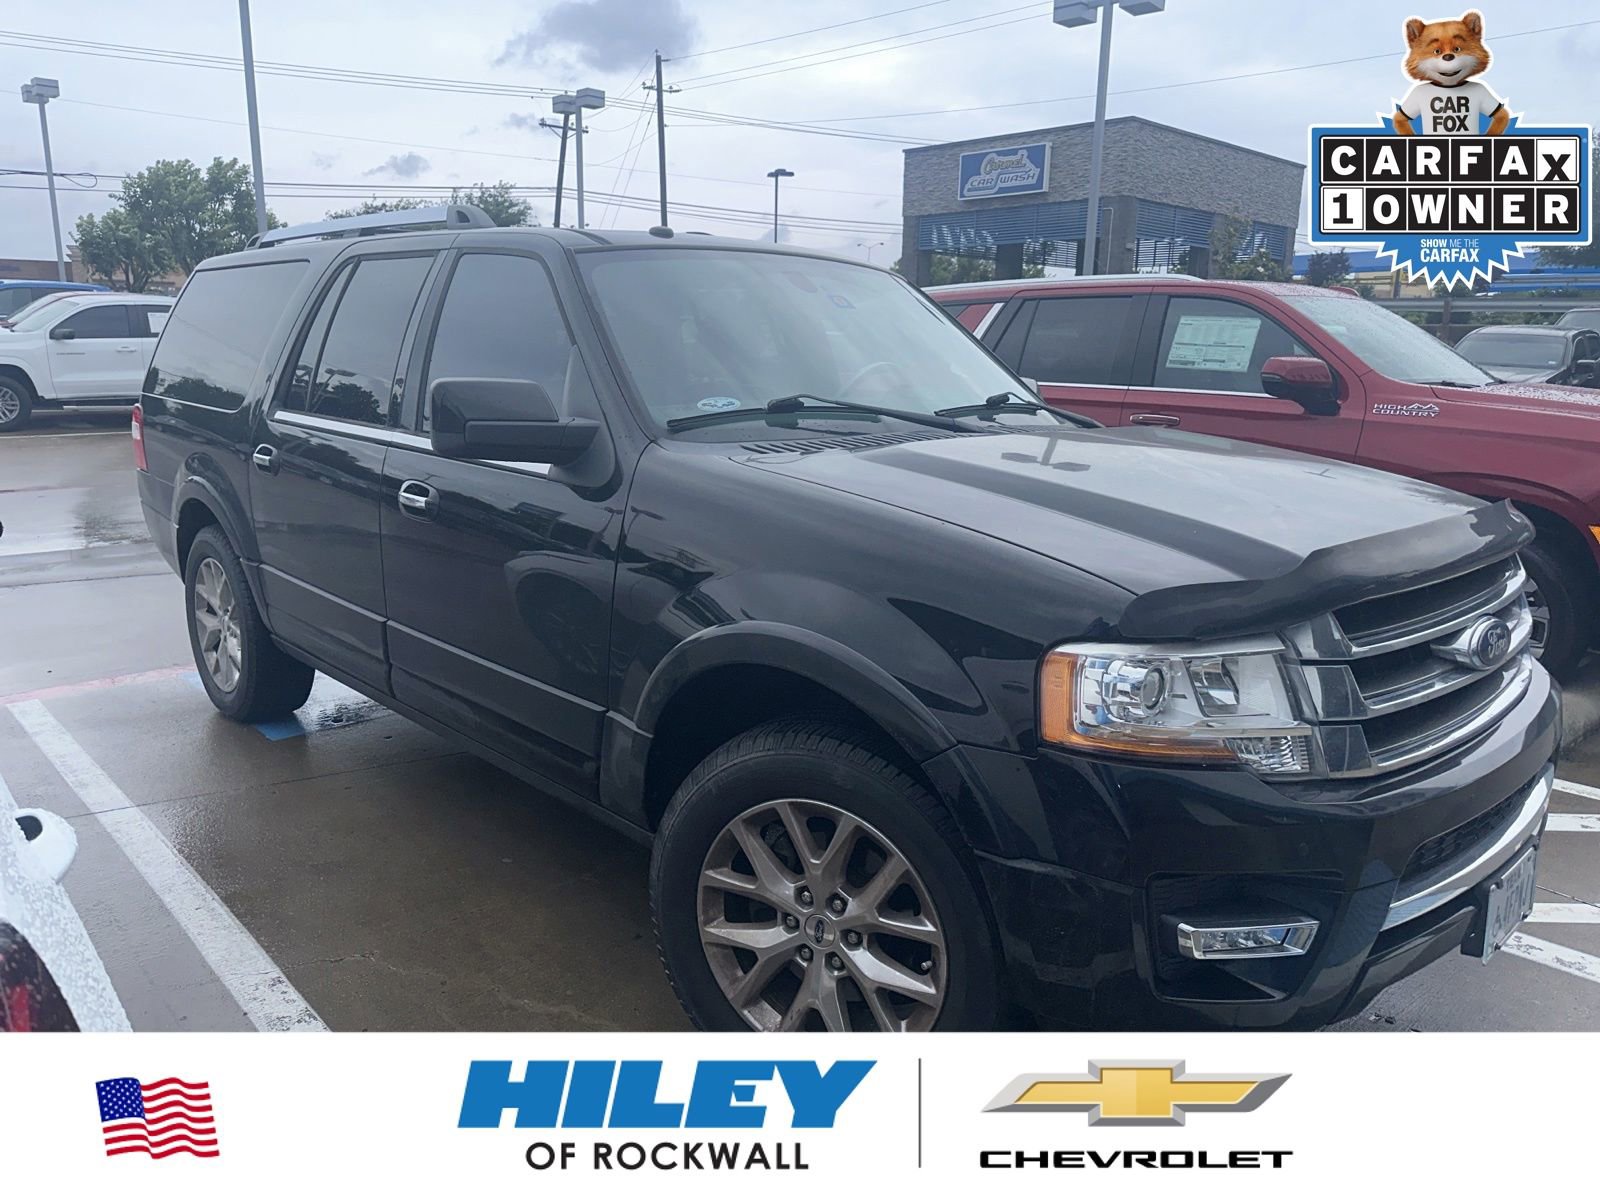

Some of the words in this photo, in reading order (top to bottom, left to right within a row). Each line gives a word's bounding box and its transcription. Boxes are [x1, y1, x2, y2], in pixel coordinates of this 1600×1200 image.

[970, 177, 994, 187] CAR
[1000, 172, 1036, 184] WASH
[1372, 409, 1439, 417] COUNTRY
